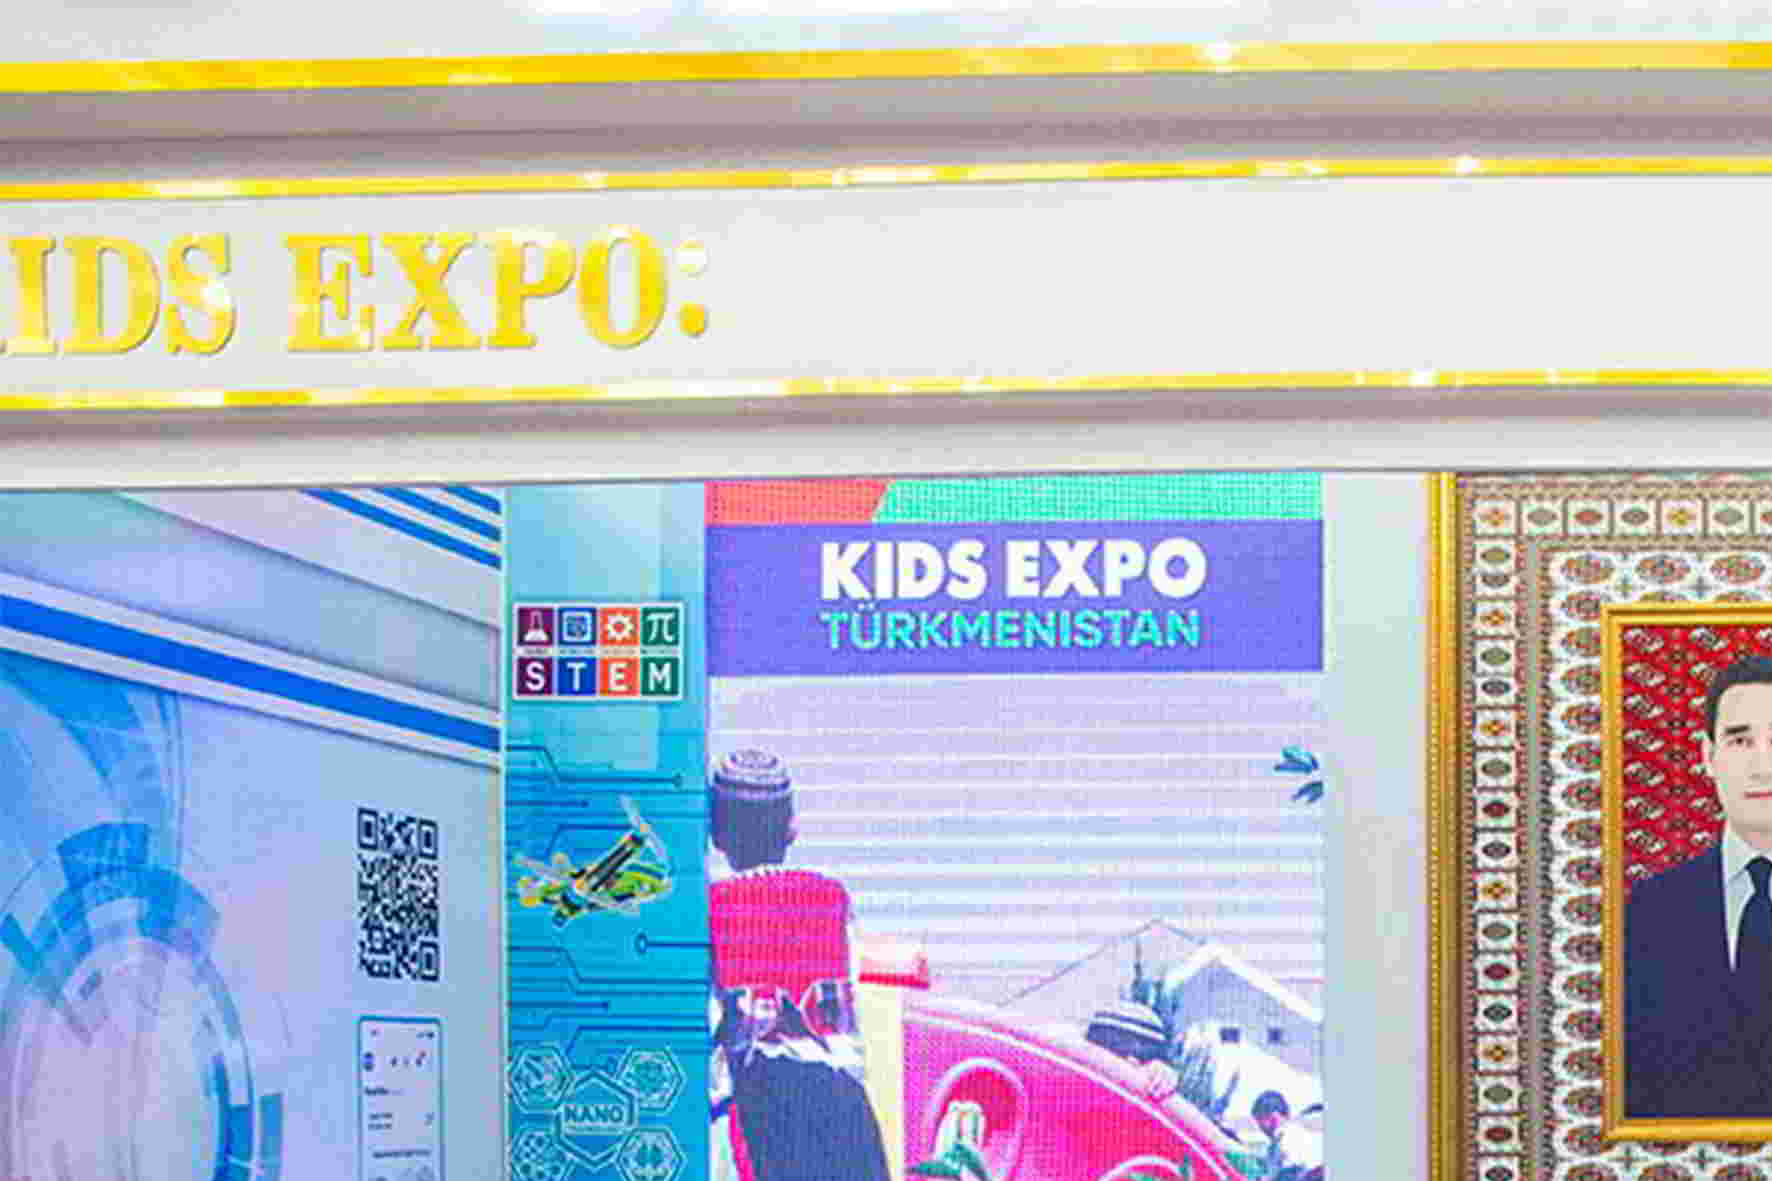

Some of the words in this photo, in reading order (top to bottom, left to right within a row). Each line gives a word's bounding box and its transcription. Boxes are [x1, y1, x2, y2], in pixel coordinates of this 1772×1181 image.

[0, 233, 237, 355] IDS
[284, 225, 707, 352] EXPO:
[820, 539, 986, 600] KIDS
[1005, 537, 1208, 600] EXPO
[818, 602, 1203, 652] TÜRKMENISTAN
[524, 660, 673, 692] STEM
